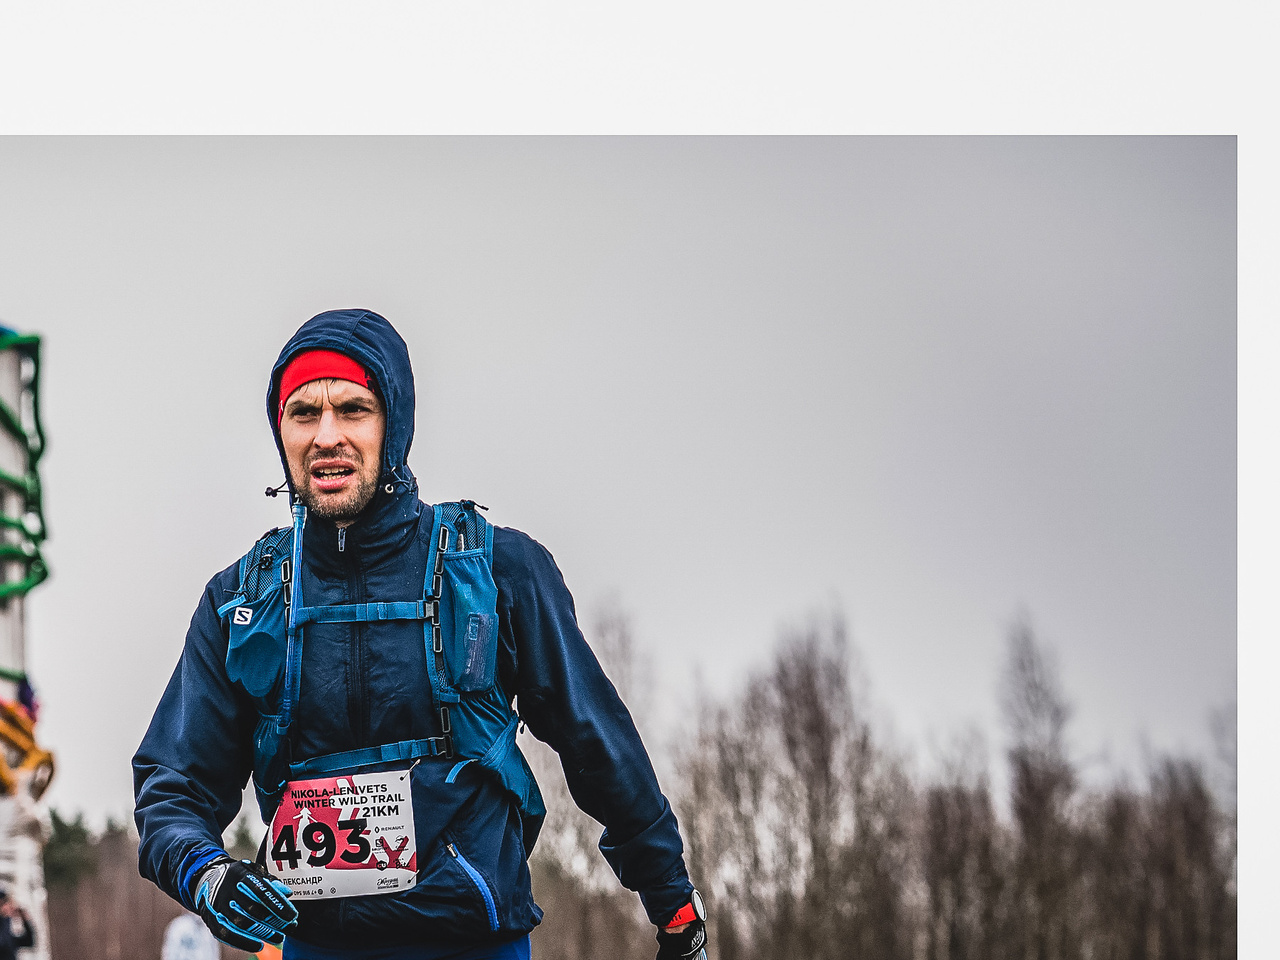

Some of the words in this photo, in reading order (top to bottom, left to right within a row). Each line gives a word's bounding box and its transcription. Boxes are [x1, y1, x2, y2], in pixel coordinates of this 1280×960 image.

[291, 784, 387, 799] NIKOLA-LENIVETS
[294, 799, 336, 809] WINTER
[338, 795, 368, 807] WILD
[370, 793, 405, 804] TRAIL
[362, 805, 400, 818] 21KM
[271, 818, 372, 869] 493
[282, 876, 323, 886] ЛЕКСАНДР
[265, 891, 284, 910] WIND
